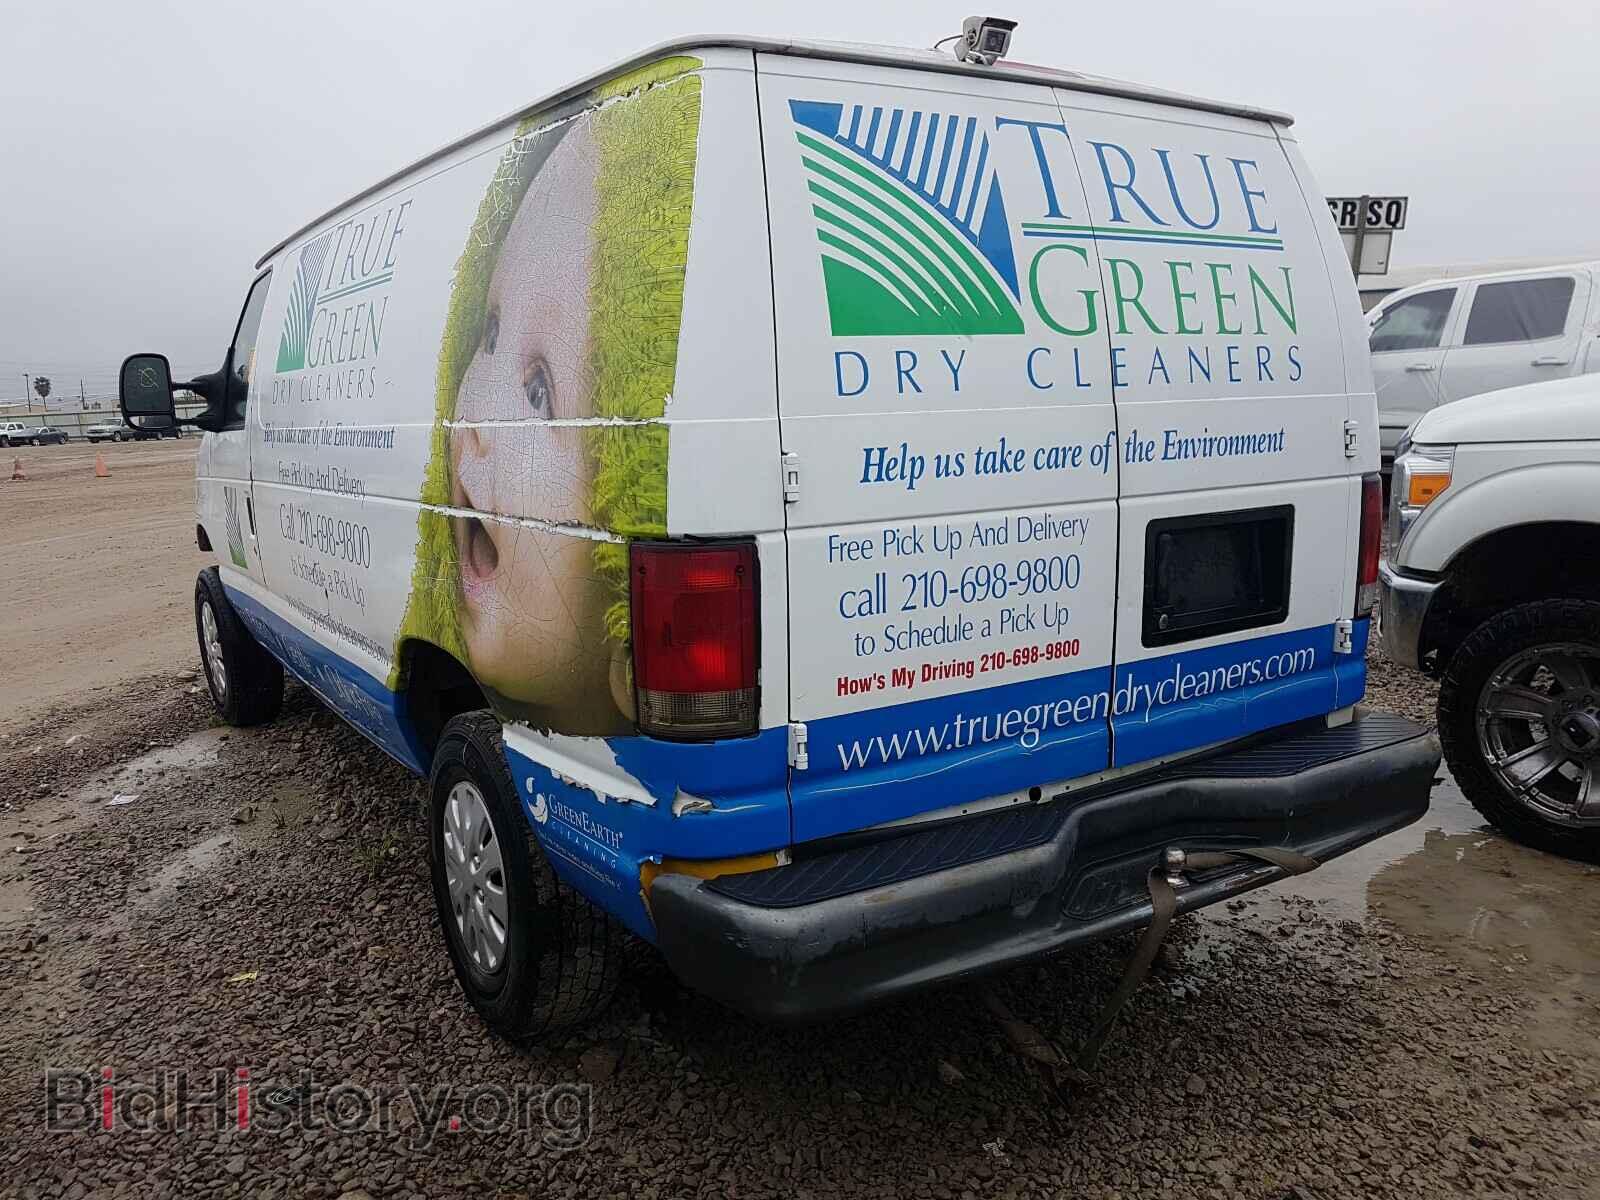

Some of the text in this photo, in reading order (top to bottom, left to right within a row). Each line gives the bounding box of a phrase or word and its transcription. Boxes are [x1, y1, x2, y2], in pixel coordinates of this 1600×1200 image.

[995, 117, 1278, 235] TRUE
[326, 200, 413, 291] TRUE
[1028, 243, 1298, 336] GREEN
[307, 296, 391, 368] GREEN
[272, 366, 376, 405] DRY CLEANERS
[835, 345, 1302, 397] DRY CLEANERS
[333, 423, 395, 449] Environment
[860, 426, 1286, 490] Help us take care of the Environment
[279, 503, 371, 569] Call 210-698-9800
[828, 511, 1090, 564] Free Pick Up And Delivery
[839, 554, 1081, 620] call 210-698-9800
[855, 602, 1069, 657] to Schedule a Pick Up
[836, 638, 1081, 696] How's My Driving 210-698-9800
[836, 646, 1315, 771] www.truegreendrycleaners.com
